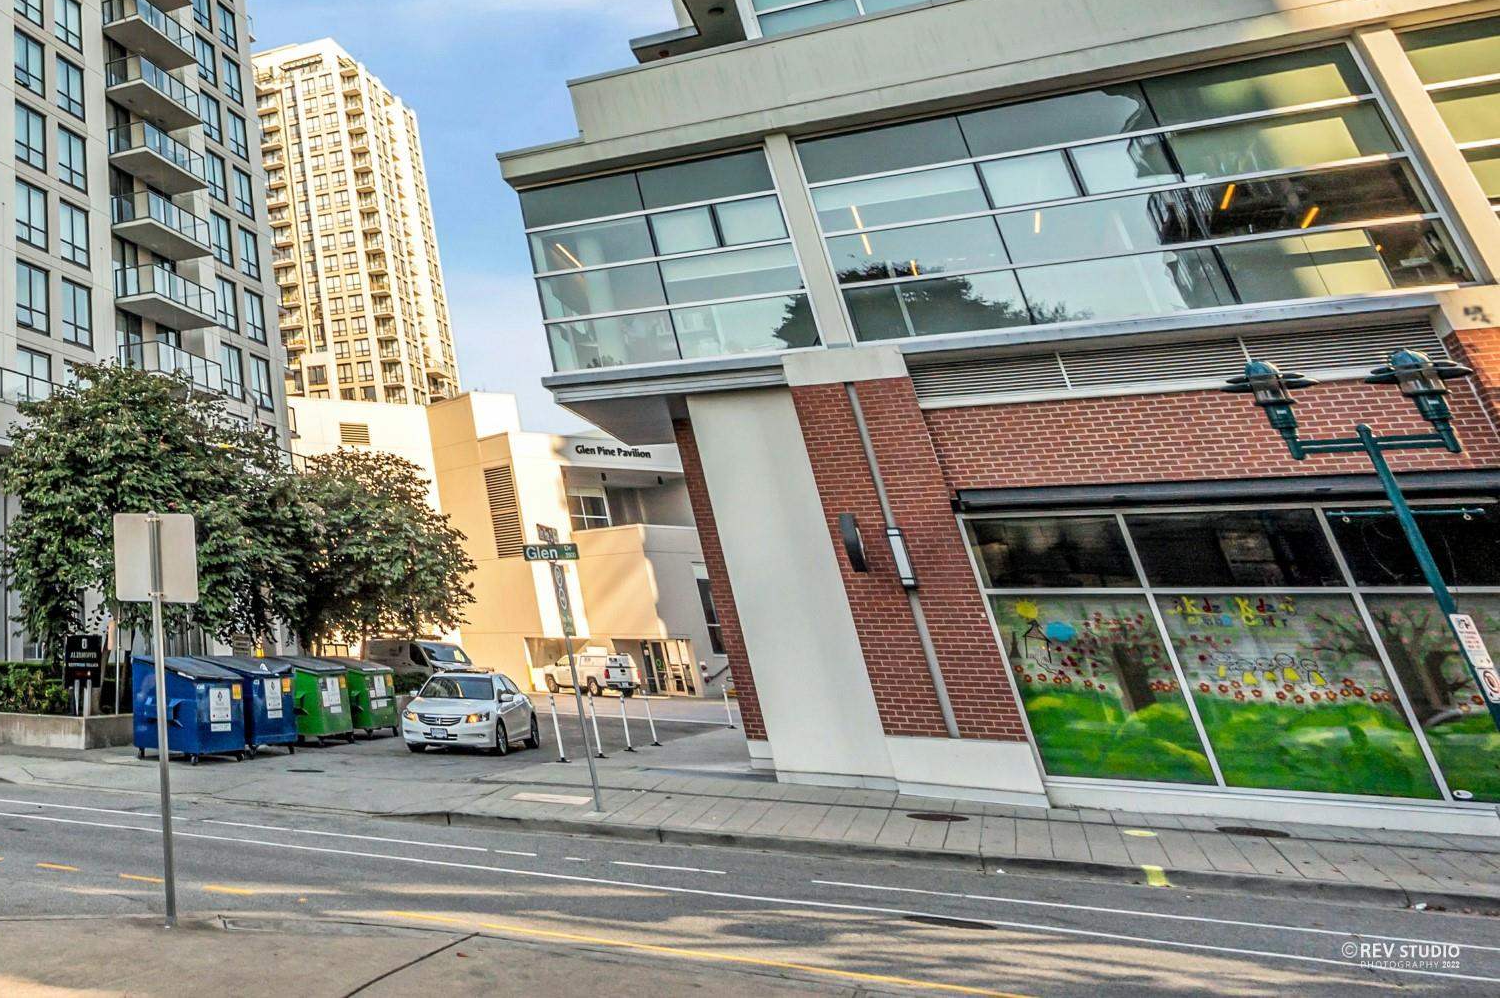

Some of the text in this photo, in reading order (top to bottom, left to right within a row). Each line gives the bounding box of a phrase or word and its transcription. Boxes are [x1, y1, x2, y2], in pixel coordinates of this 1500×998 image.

[575, 445, 652, 458] Glen Pine Pavilion
[525, 545, 559, 560] Glen
